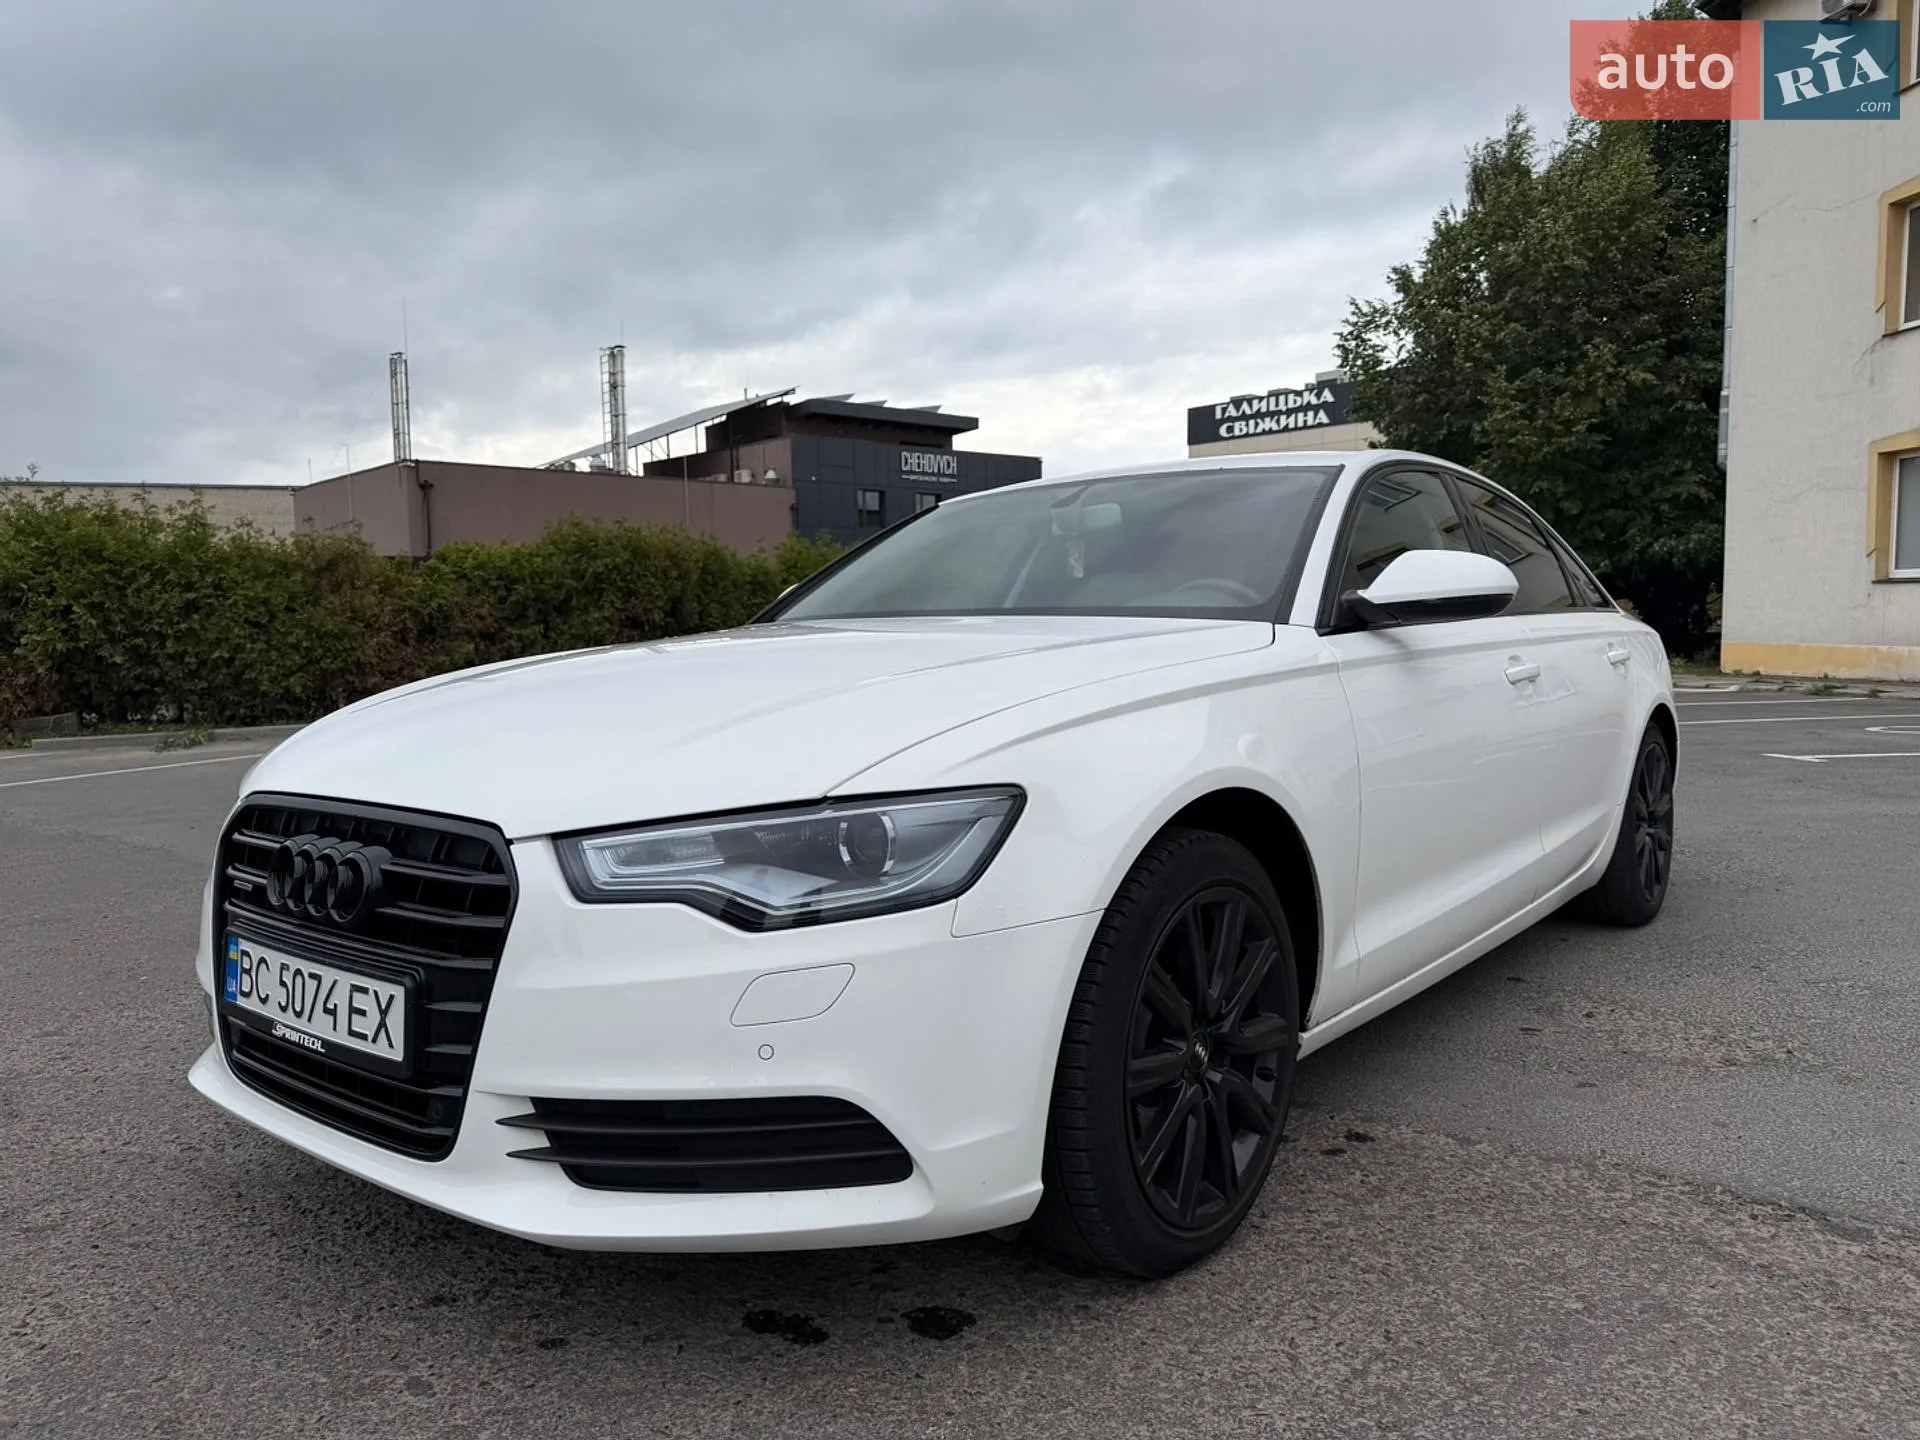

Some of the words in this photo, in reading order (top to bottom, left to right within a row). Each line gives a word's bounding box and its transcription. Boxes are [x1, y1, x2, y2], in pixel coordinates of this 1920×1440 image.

[1215, 387, 1335, 419] ГАЛИЦЬКА
[1219, 409, 1330, 437] СВІЖИНА
[901, 451, 957, 475] CHEHOVYCH
[240, 949, 271, 1005] BC
[278, 963, 339, 1032] 5074
[347, 983, 397, 1049] EX
